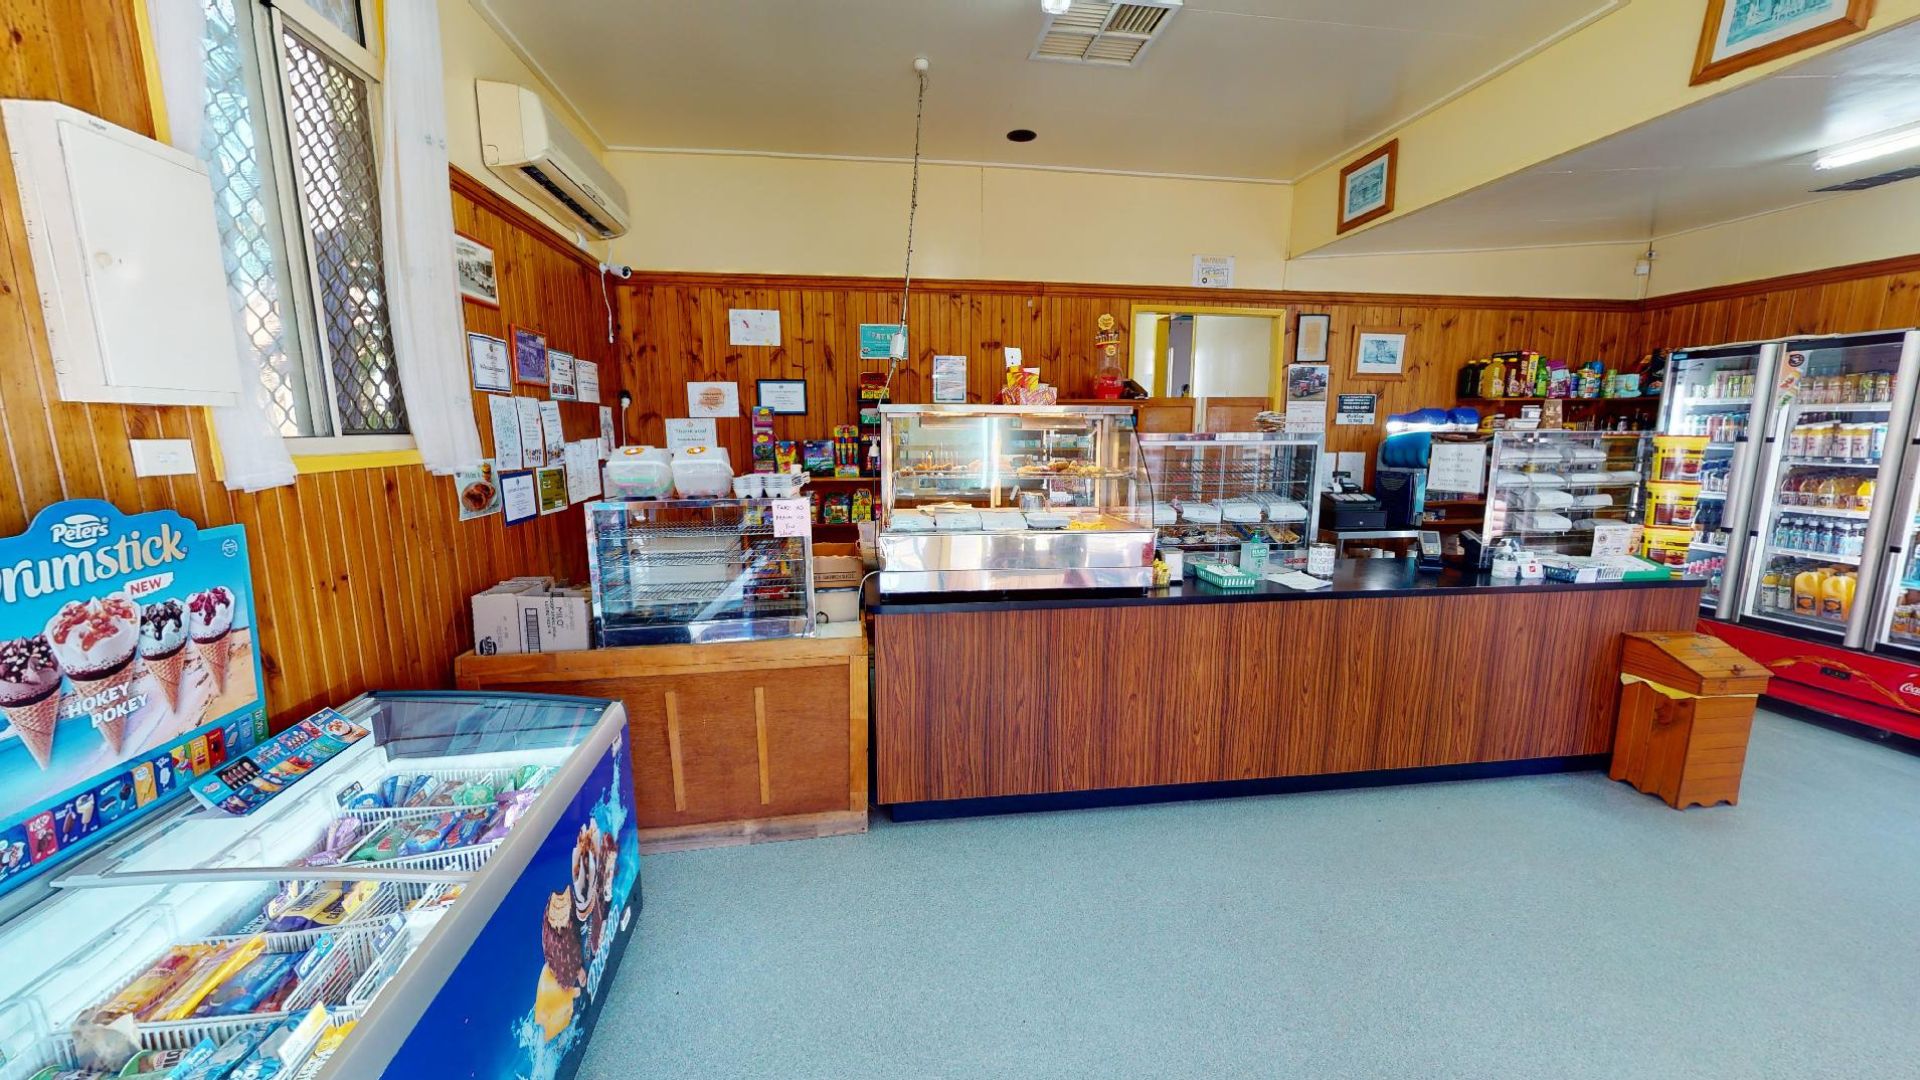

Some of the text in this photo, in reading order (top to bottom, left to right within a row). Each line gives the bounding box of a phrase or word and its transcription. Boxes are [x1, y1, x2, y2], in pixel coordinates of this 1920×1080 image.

[50, 523, 109, 543] Peters
[0, 523, 187, 603] rumstick
[130, 577, 162, 596] NEW
[69, 681, 130, 719] HOKEY
[91, 693, 148, 729] POKEY
